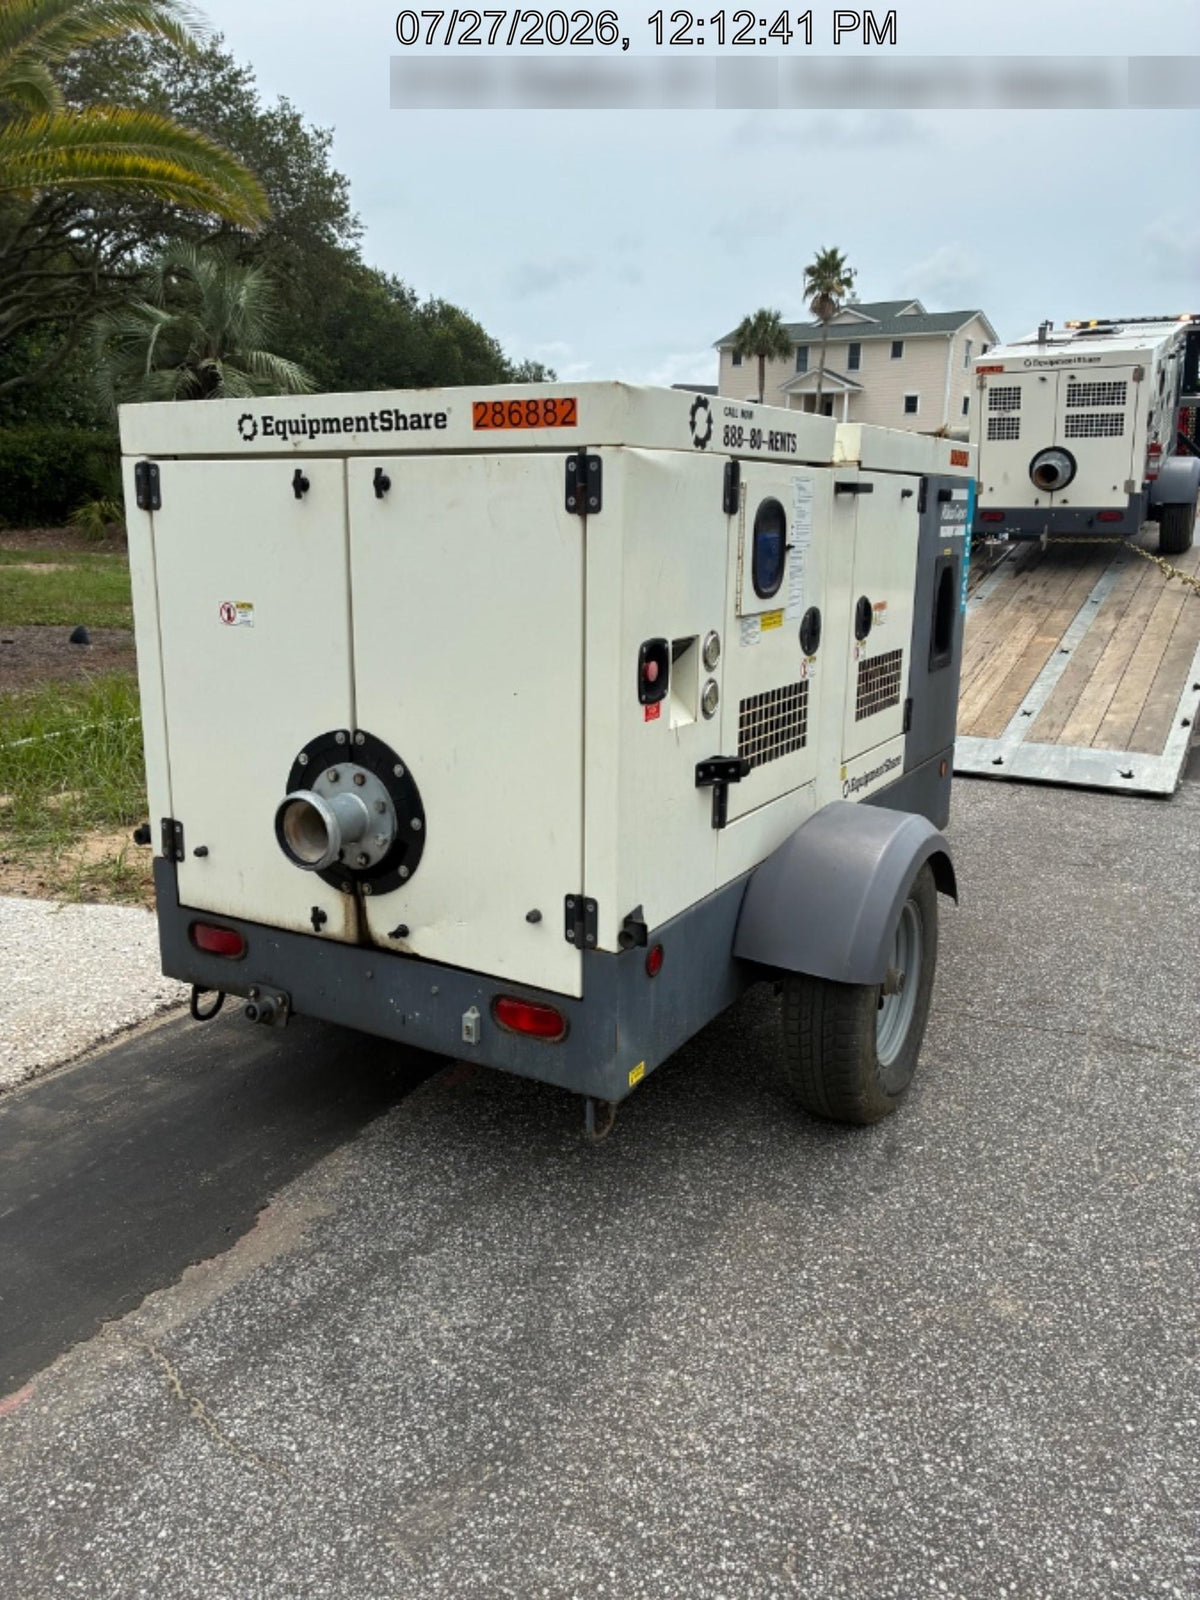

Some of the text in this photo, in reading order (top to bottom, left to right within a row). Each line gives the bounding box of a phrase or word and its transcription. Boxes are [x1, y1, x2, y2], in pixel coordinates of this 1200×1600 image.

[261, 409, 448, 440] EquipmentShare
[474, 398, 577, 428] 286882
[723, 406, 739, 419] CALL
